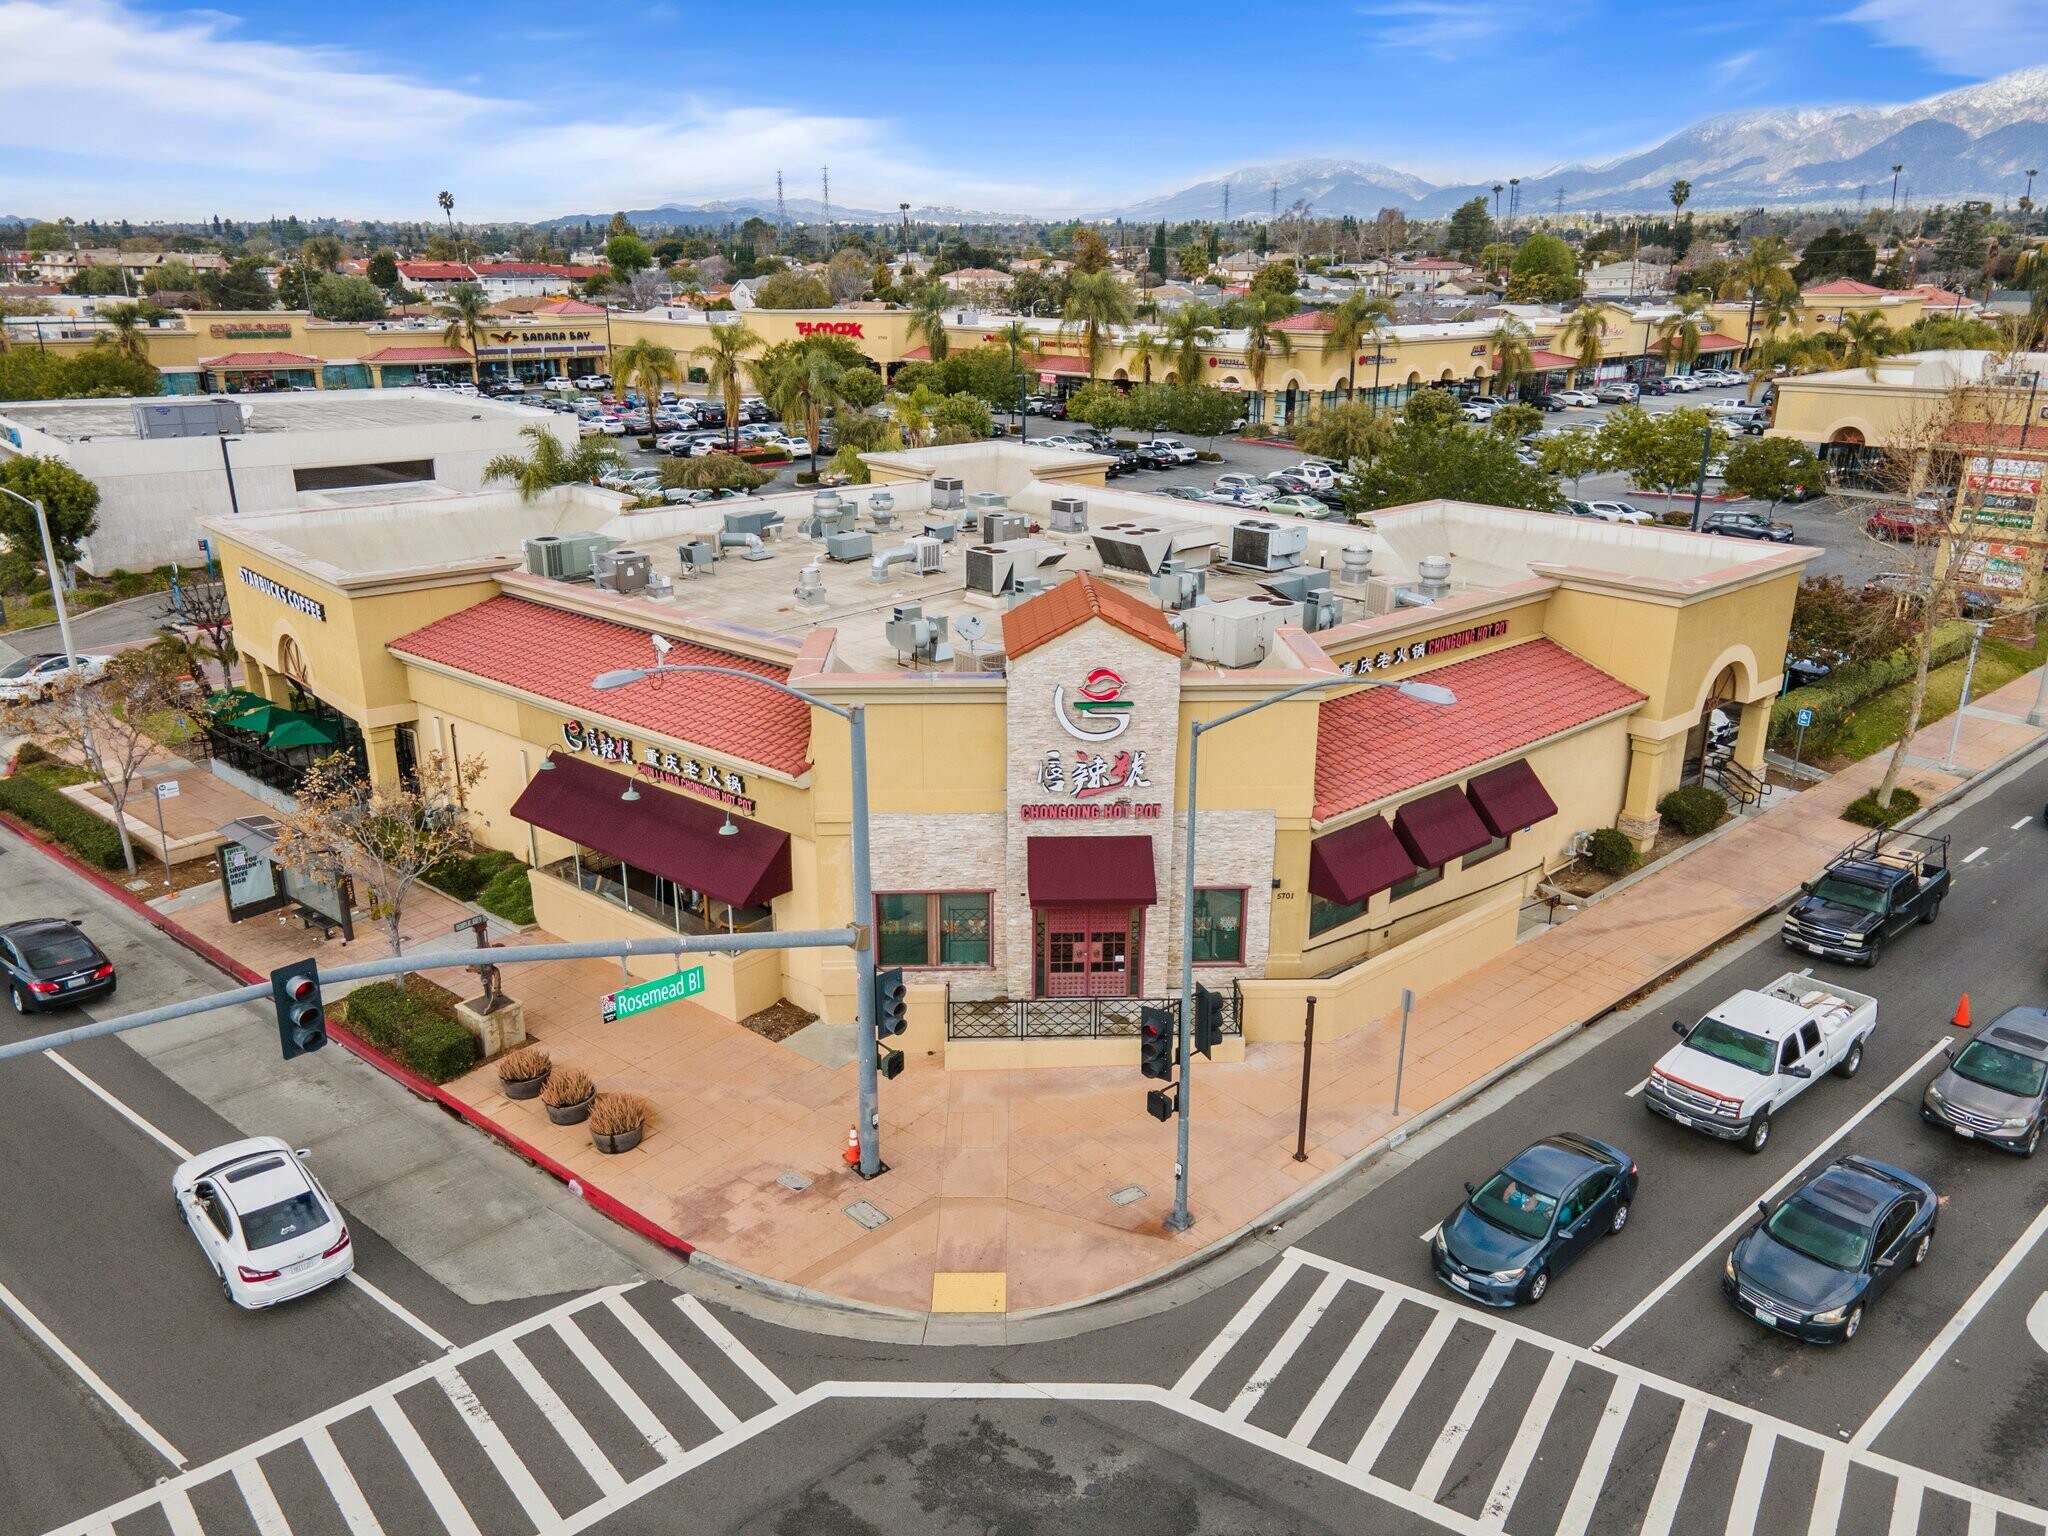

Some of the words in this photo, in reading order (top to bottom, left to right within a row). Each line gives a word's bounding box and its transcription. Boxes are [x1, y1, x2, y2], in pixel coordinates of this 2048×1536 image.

[522, 332, 566, 341] BANANA
[569, 331, 590, 340] BAY
[240, 566, 287, 604] STARBUCKS
[287, 590, 324, 622] COFFEE
[1341, 643, 1426, 678] 重庆老火锅
[1428, 629, 1475, 655] CHONGQING
[1476, 624, 1493, 641] HOT
[1494, 620, 1509, 637] POT
[644, 747, 743, 795] 重庆老火锅
[637, 763, 655, 777] CHUN
[655, 769, 664, 780] LA
[665, 773, 679, 786] HAO
[680, 778, 720, 800] CHONGQING
[721, 791, 735, 805] HOT
[737, 798, 753, 811] POT
[1021, 804, 1100, 820] CHONGQING
[1104, 804, 1131, 819] HOT
[1135, 804, 1162, 819] POT
[245, 855, 257, 863] YOU
[229, 860, 263, 874] SHOULDN'T
[230, 870, 248, 880] DRIVE
[231, 876, 246, 885] HIGH
[1276, 892, 1295, 900] 5701
[618, 975, 684, 1014] Rosemead
[688, 969, 701, 992] Bl
